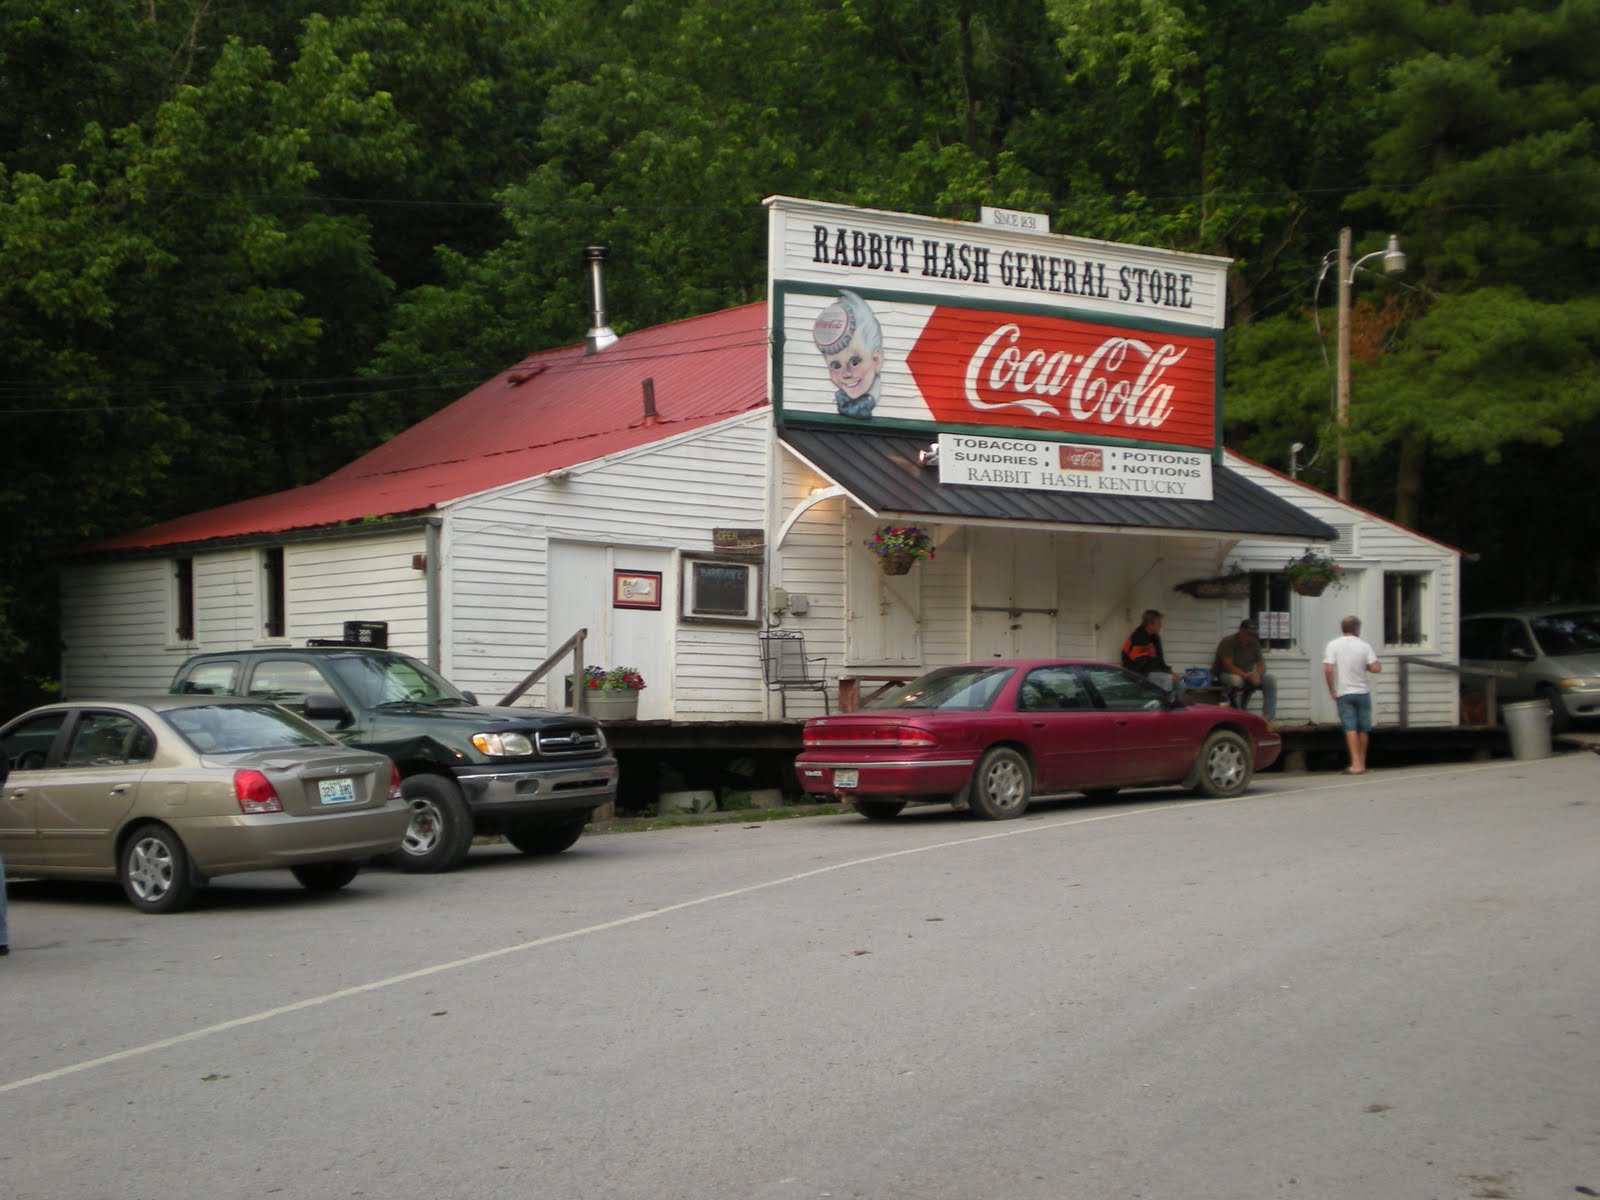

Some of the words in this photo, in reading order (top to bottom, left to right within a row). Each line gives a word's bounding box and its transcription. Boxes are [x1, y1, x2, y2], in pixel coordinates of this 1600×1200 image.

[993, 209, 1019, 227] SINCE
[812, 224, 914, 274] RABBIT
[921, 239, 990, 284] HASH
[1000, 250, 1110, 299] GENERAL
[1119, 265, 1193, 309] STORE
[965, 324, 1188, 427] Coca-Cola
[953, 438, 1037, 453] TOBACCO
[954, 452, 1039, 467] SUNDRIES
[1122, 452, 1201, 466] POTIONS
[1122, 464, 1201, 478] NOTIONS
[967, 467, 1032, 485] RABBIT
[1098, 476, 1187, 495] KENTUCKY
